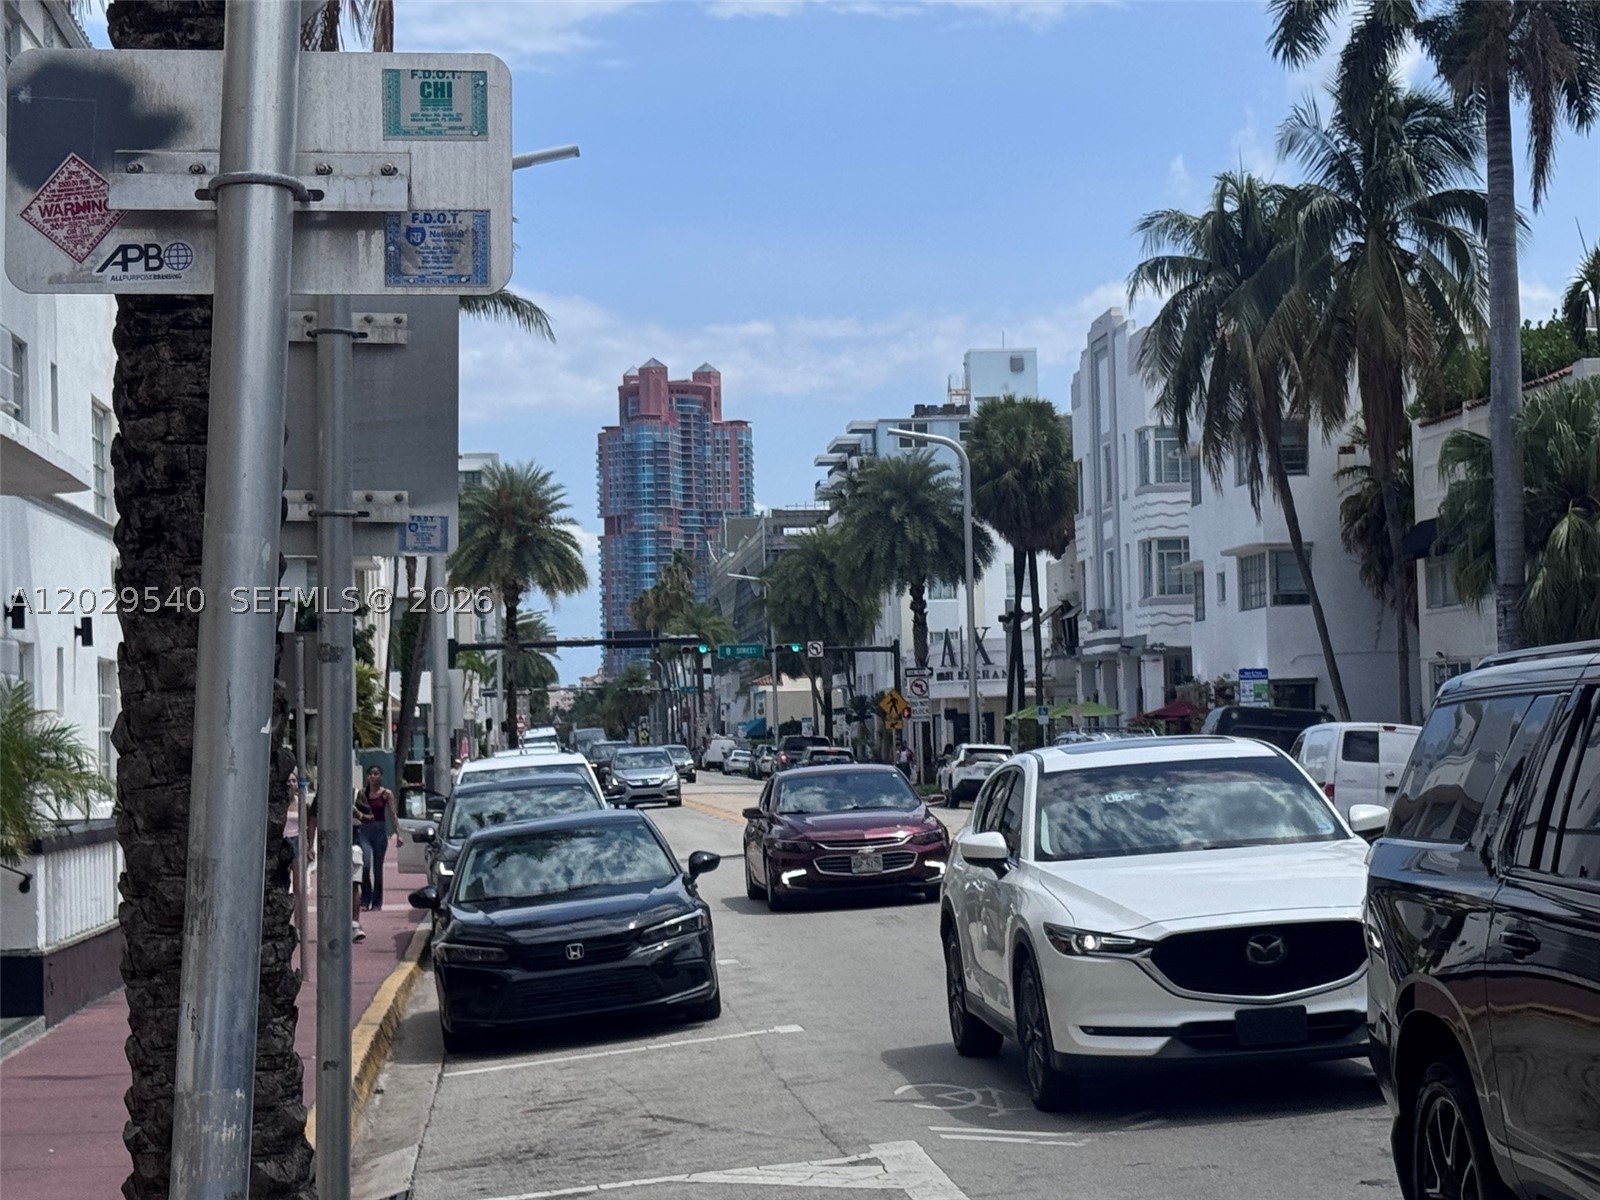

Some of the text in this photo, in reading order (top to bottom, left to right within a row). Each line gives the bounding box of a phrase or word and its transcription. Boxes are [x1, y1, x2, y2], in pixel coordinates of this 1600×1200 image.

[411, 70, 462, 80] F.D.O.T.
[420, 81, 453, 99] CHI
[411, 211, 463, 224] F.D.O.T.
[429, 230, 465, 239] National
[96, 243, 165, 273] APB
